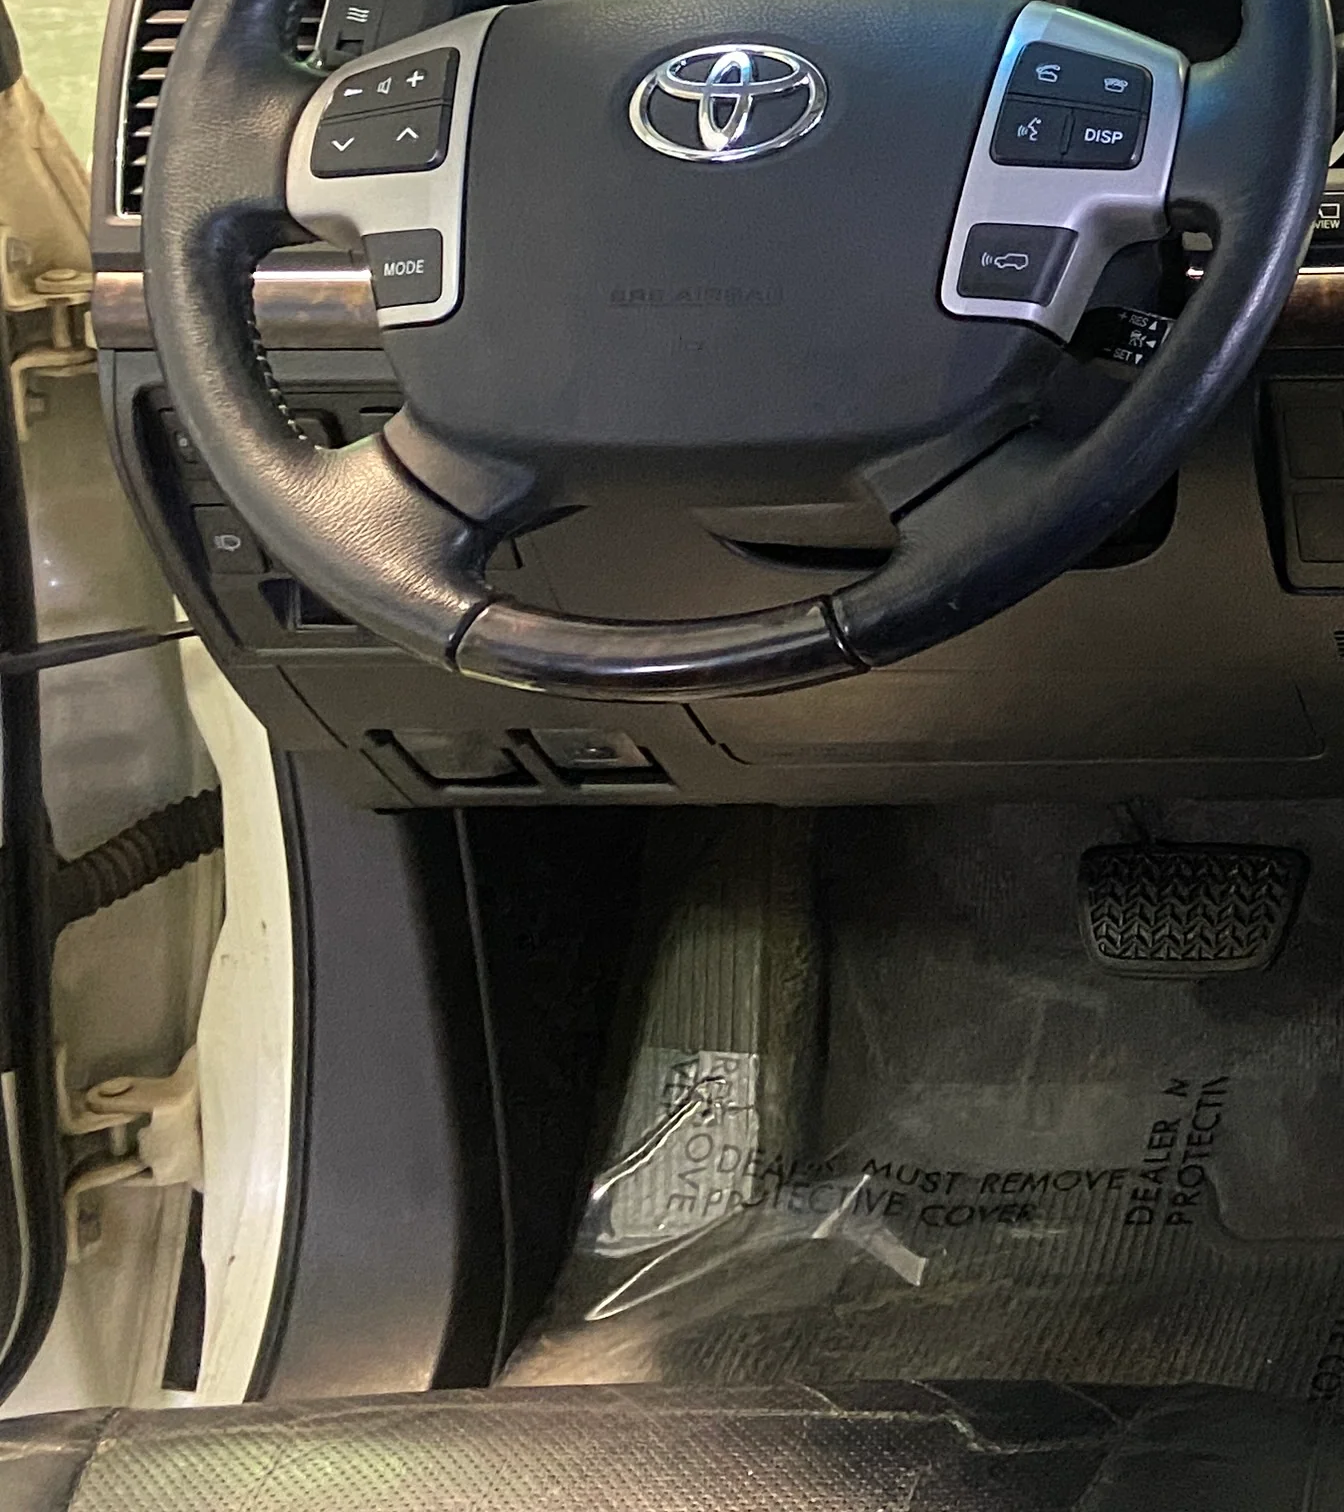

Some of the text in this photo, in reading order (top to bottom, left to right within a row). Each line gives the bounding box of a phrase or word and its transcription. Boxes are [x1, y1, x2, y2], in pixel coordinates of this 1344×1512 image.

[1084, 128, 1123, 145] DISP
[1315, 219, 1340, 229] VIEW
[383, 259, 425, 277] MODE
[1128, 314, 1149, 328] RES
[1112, 347, 1133, 361] SET
[864, 1157, 965, 1194] MUST
[981, 1168, 1130, 1194] REMOVE
[1125, 1117, 1180, 1227] DEALER
[919, 1202, 1037, 1228] COVER
